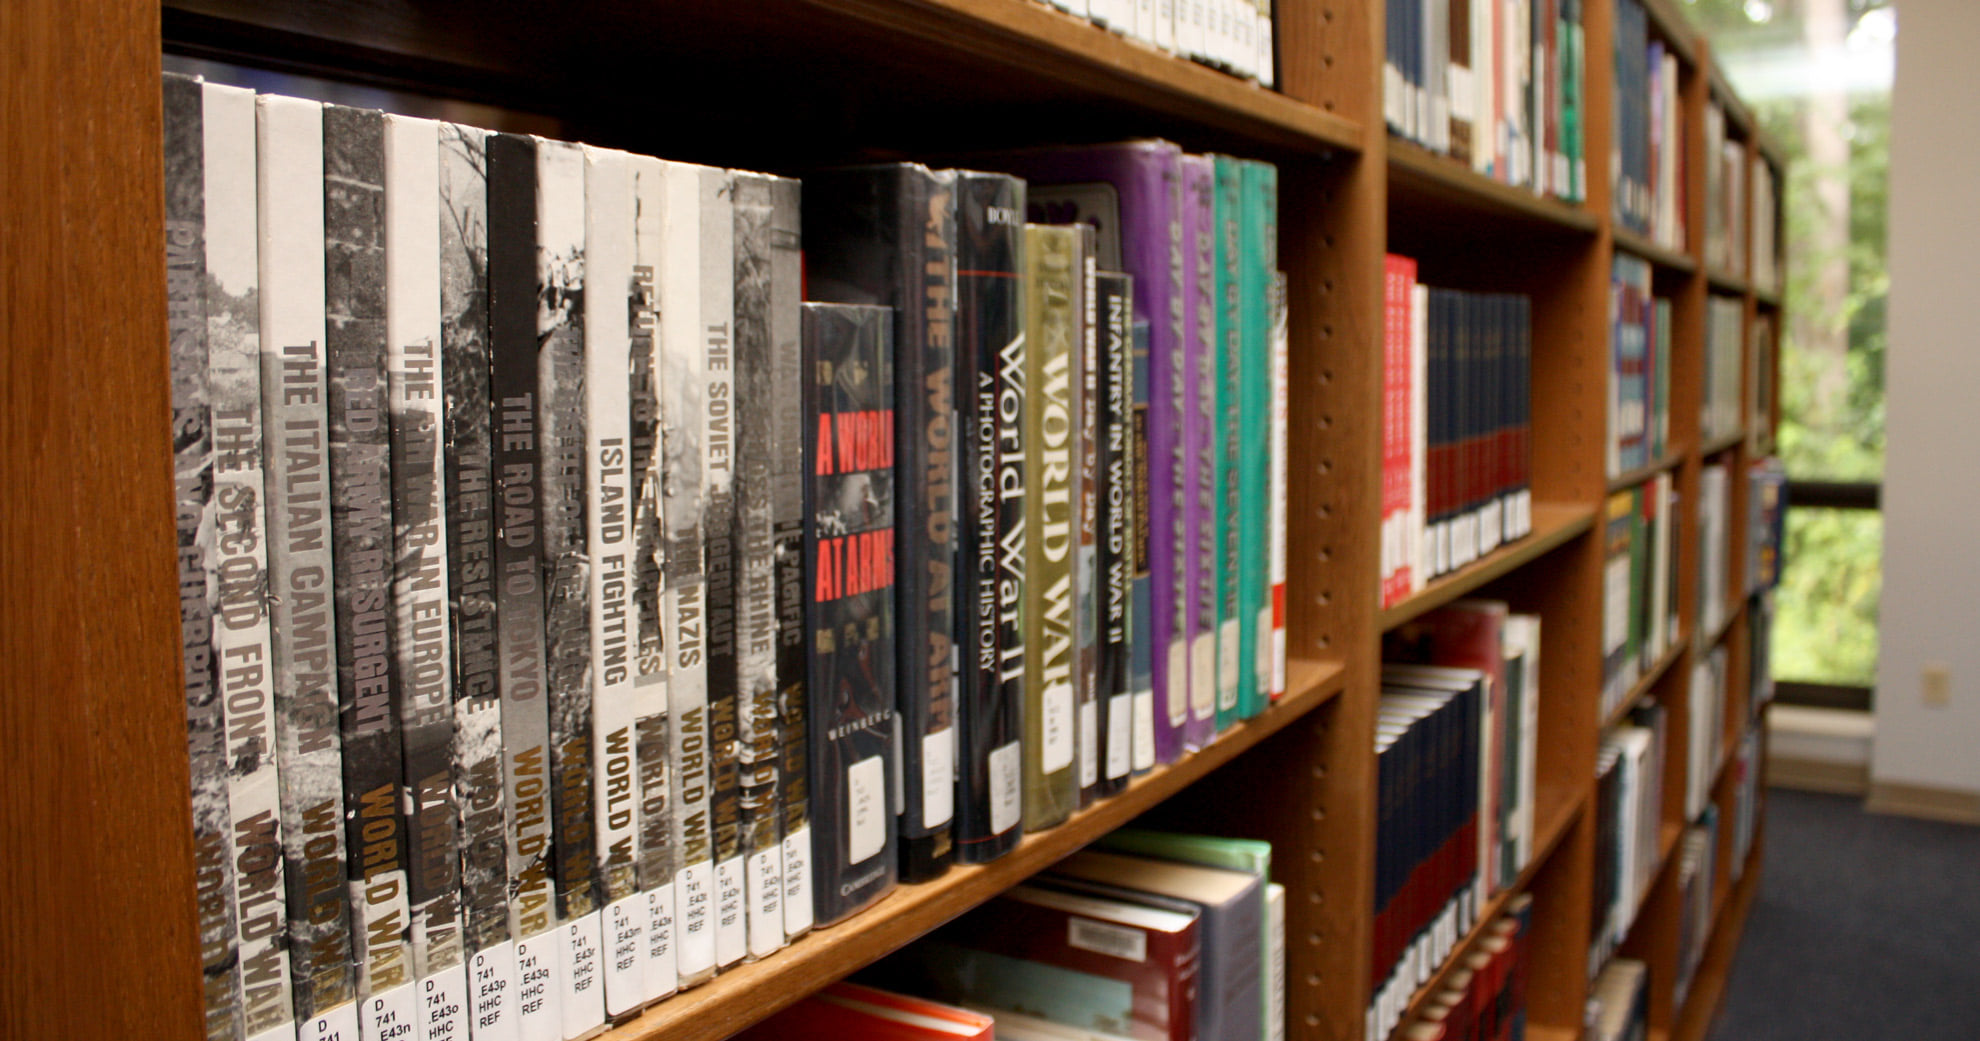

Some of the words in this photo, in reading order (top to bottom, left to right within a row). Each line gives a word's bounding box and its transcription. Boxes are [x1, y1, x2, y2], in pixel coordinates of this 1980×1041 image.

[631, 265, 657, 373] RETURN
[926, 255, 951, 348] THE
[1084, 257, 1096, 326] WORLD
[283, 340, 318, 405] THE
[403, 340, 435, 401] THE
[707, 321, 729, 371] THE
[1084, 327, 1096, 372] WAR
[1108, 294, 1122, 416] INFANTRY
[344, 367, 378, 432] RED
[631, 391, 656, 422] TO
[978, 371, 995, 387] A
[1084, 374, 1096, 390] II
[216, 410, 255, 473] THE
[405, 410, 438, 465] AIR
[502, 392, 533, 452] THE
[553, 388, 583, 490] BATTLE
[707, 380, 730, 473] SOVIET
[816, 412, 834, 476] A
[1000, 331, 1026, 504] World
[1108, 423, 1122, 452] IN
[285, 420, 324, 553] ITALIAN
[458, 453, 490, 516] THE
[632, 436, 659, 488] THE
[926, 366, 952, 545] WORLD
[978, 391, 996, 572] PHOTOGRAPHIC
[1042, 351, 1071, 563] WORLD
[346, 442, 384, 538] ARMY
[406, 471, 440, 548] WAR
[503, 463, 536, 548] ROAD
[557, 499, 584, 537] OF
[599, 437, 625, 545] ISLAND
[1109, 459, 1122, 554] WORLD
[217, 485, 262, 631] SECOND
[705, 483, 733, 657] JUGGERNAUT
[749, 517, 772, 569] THE
[816, 537, 844, 602] AT
[1000, 517, 1027, 631] War
[1225, 467, 1237, 619] SEVENTIE
[409, 556, 442, 594] IN
[506, 556, 537, 596] TO
[780, 550, 804, 647] PACIFIC
[927, 559, 952, 613] AT
[1109, 562, 1123, 623] WAR
[350, 549, 393, 733] RESURGENT
[460, 520, 495, 716] RESISTANCE
[601, 553, 628, 688] FIGHTING
[676, 585, 702, 669] NAZIS
[750, 573, 773, 655] RHINE
[979, 578, 997, 673] HISTORY
[1109, 631, 1123, 645] II
[289, 565, 332, 755] CAMPAIGN
[411, 600, 449, 728] EUROPE
[507, 602, 540, 702] TOKYO
[928, 630, 954, 734] ARM
[1001, 644, 1026, 684] II
[225, 642, 268, 757] FRONT
[781, 681, 807, 774] WORLD
[828, 709, 891, 741] WEINBERG
[636, 715, 665, 816] WORLD
[680, 706, 706, 805] WORLD
[711, 695, 738, 796] WORLD
[752, 689, 777, 784] WORLD
[513, 745, 546, 857] WORLD
[561, 736, 590, 844] WORLD
[605, 726, 633, 833] WORLD
[360, 781, 400, 906] WORLD
[418, 769, 454, 891] WORLD
[469, 756, 502, 869] WORLD
[234, 809, 280, 943] WORLD
[302, 798, 342, 926] WORLD
[686, 869, 693, 881] D
[687, 882, 701, 894] 741
[719, 866, 725, 876] D
[194, 831, 229, 968] WORLD
[519, 861, 549, 936] WAR
[614, 905, 621, 916] D
[615, 917, 629, 930] 741
[649, 893, 656, 905] D
[649, 905, 664, 918] 741
[687, 906, 706, 920] HHC
[688, 920, 705, 935] REF
[721, 914, 737, 928] REF
[367, 911, 406, 993] WAR
[424, 898, 460, 974] WAR
[477, 955, 485, 967] D
[519, 944, 527, 956] D
[571, 925, 578, 936] D
[571, 936, 587, 951] 741
[616, 942, 636, 959] HHC
[650, 930, 669, 945] HHC
[650, 943, 668, 959] REF
[243, 948, 286, 1038] WAR
[426, 980, 434, 992] D
[477, 966, 494, 982] 741
[478, 979, 507, 999] .E43p
[519, 955, 537, 970] 741
[520, 968, 550, 986] .E43q
[520, 983, 545, 1001] HHC
[573, 961, 594, 979] HHC
[574, 976, 593, 993] REF
[616, 956, 635, 973] REF
[318, 1020, 327, 1032] D
[375, 999, 384, 1011] D
[375, 1010, 396, 1028] 741
[426, 991, 446, 1008] 741
[428, 1004, 459, 1025] .E43o
[428, 1020, 454, 1040] HHC
[478, 995, 502, 1014] HHC
[479, 1011, 501, 1029] REF
[522, 998, 543, 1016] REF
